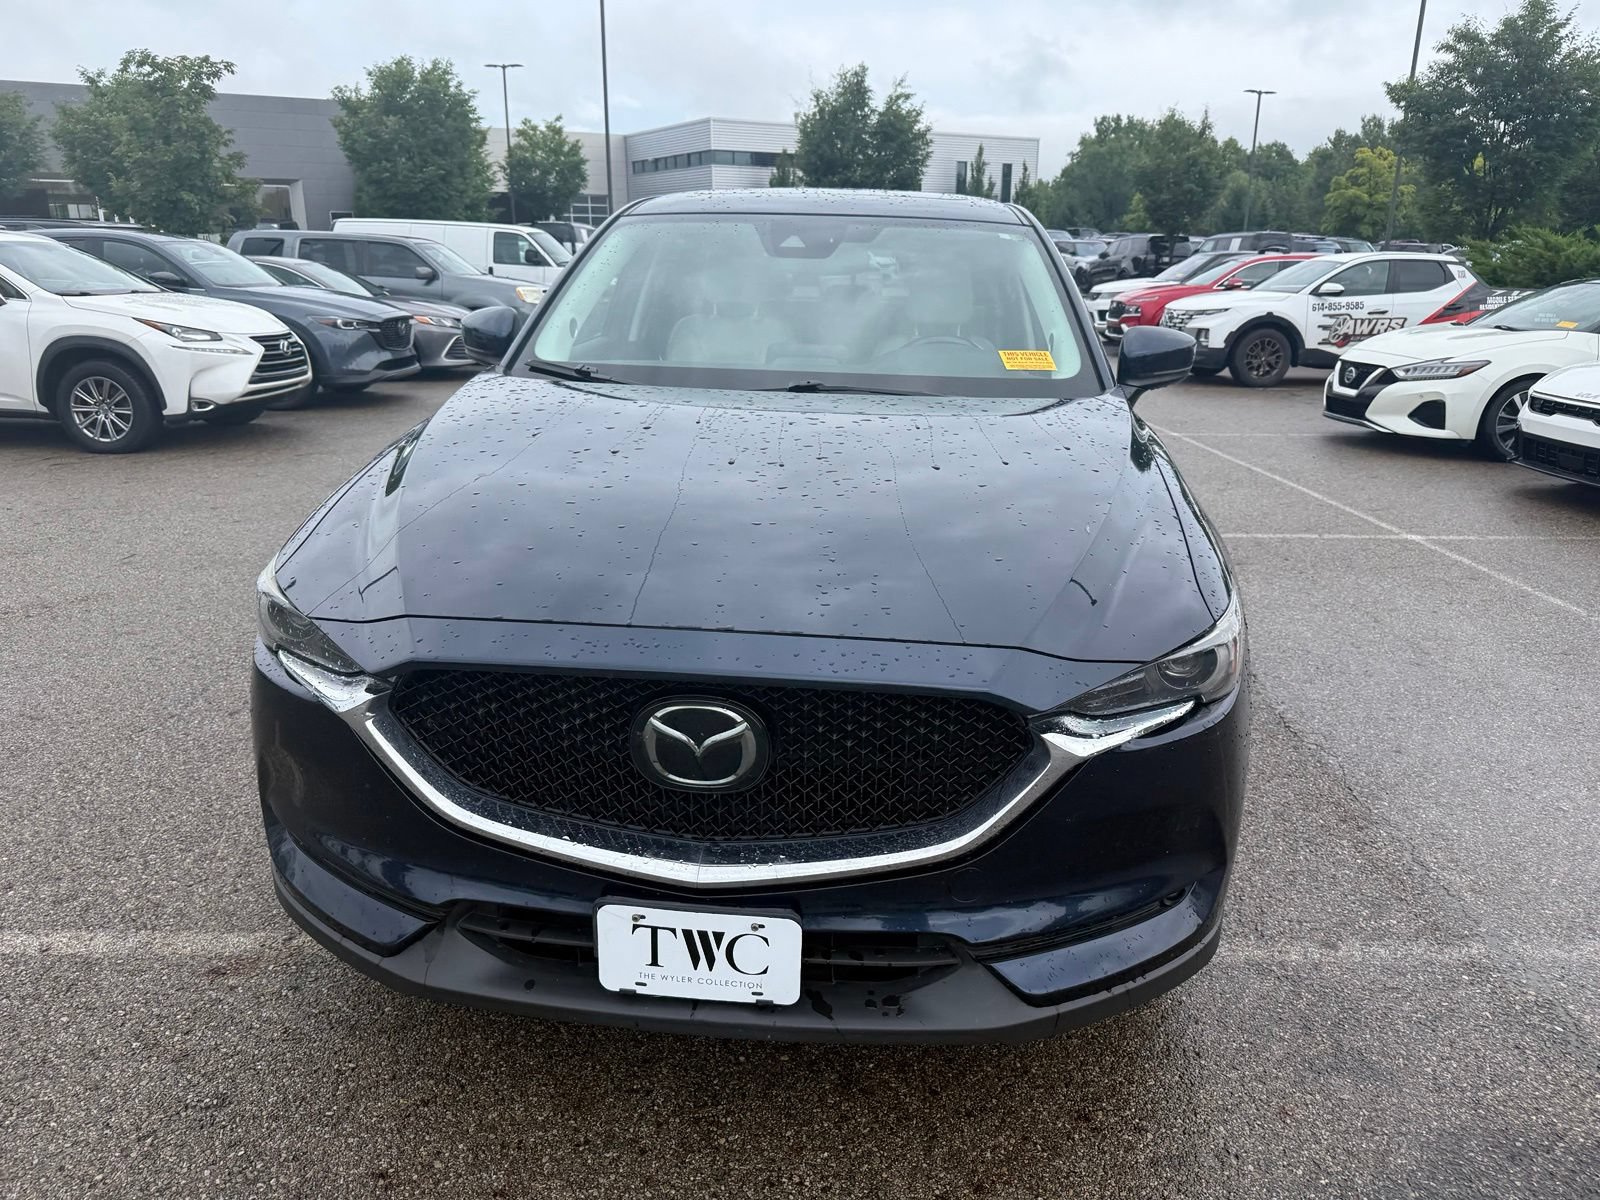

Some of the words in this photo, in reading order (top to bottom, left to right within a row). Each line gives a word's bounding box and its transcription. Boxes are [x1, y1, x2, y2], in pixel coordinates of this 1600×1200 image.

[1339, 317, 1408, 336] AWRS
[631, 923, 770, 976] TWC
[639, 972, 656, 980] THE
[660, 974, 693, 984] WYLER
[697, 977, 763, 989] COLLECTION
